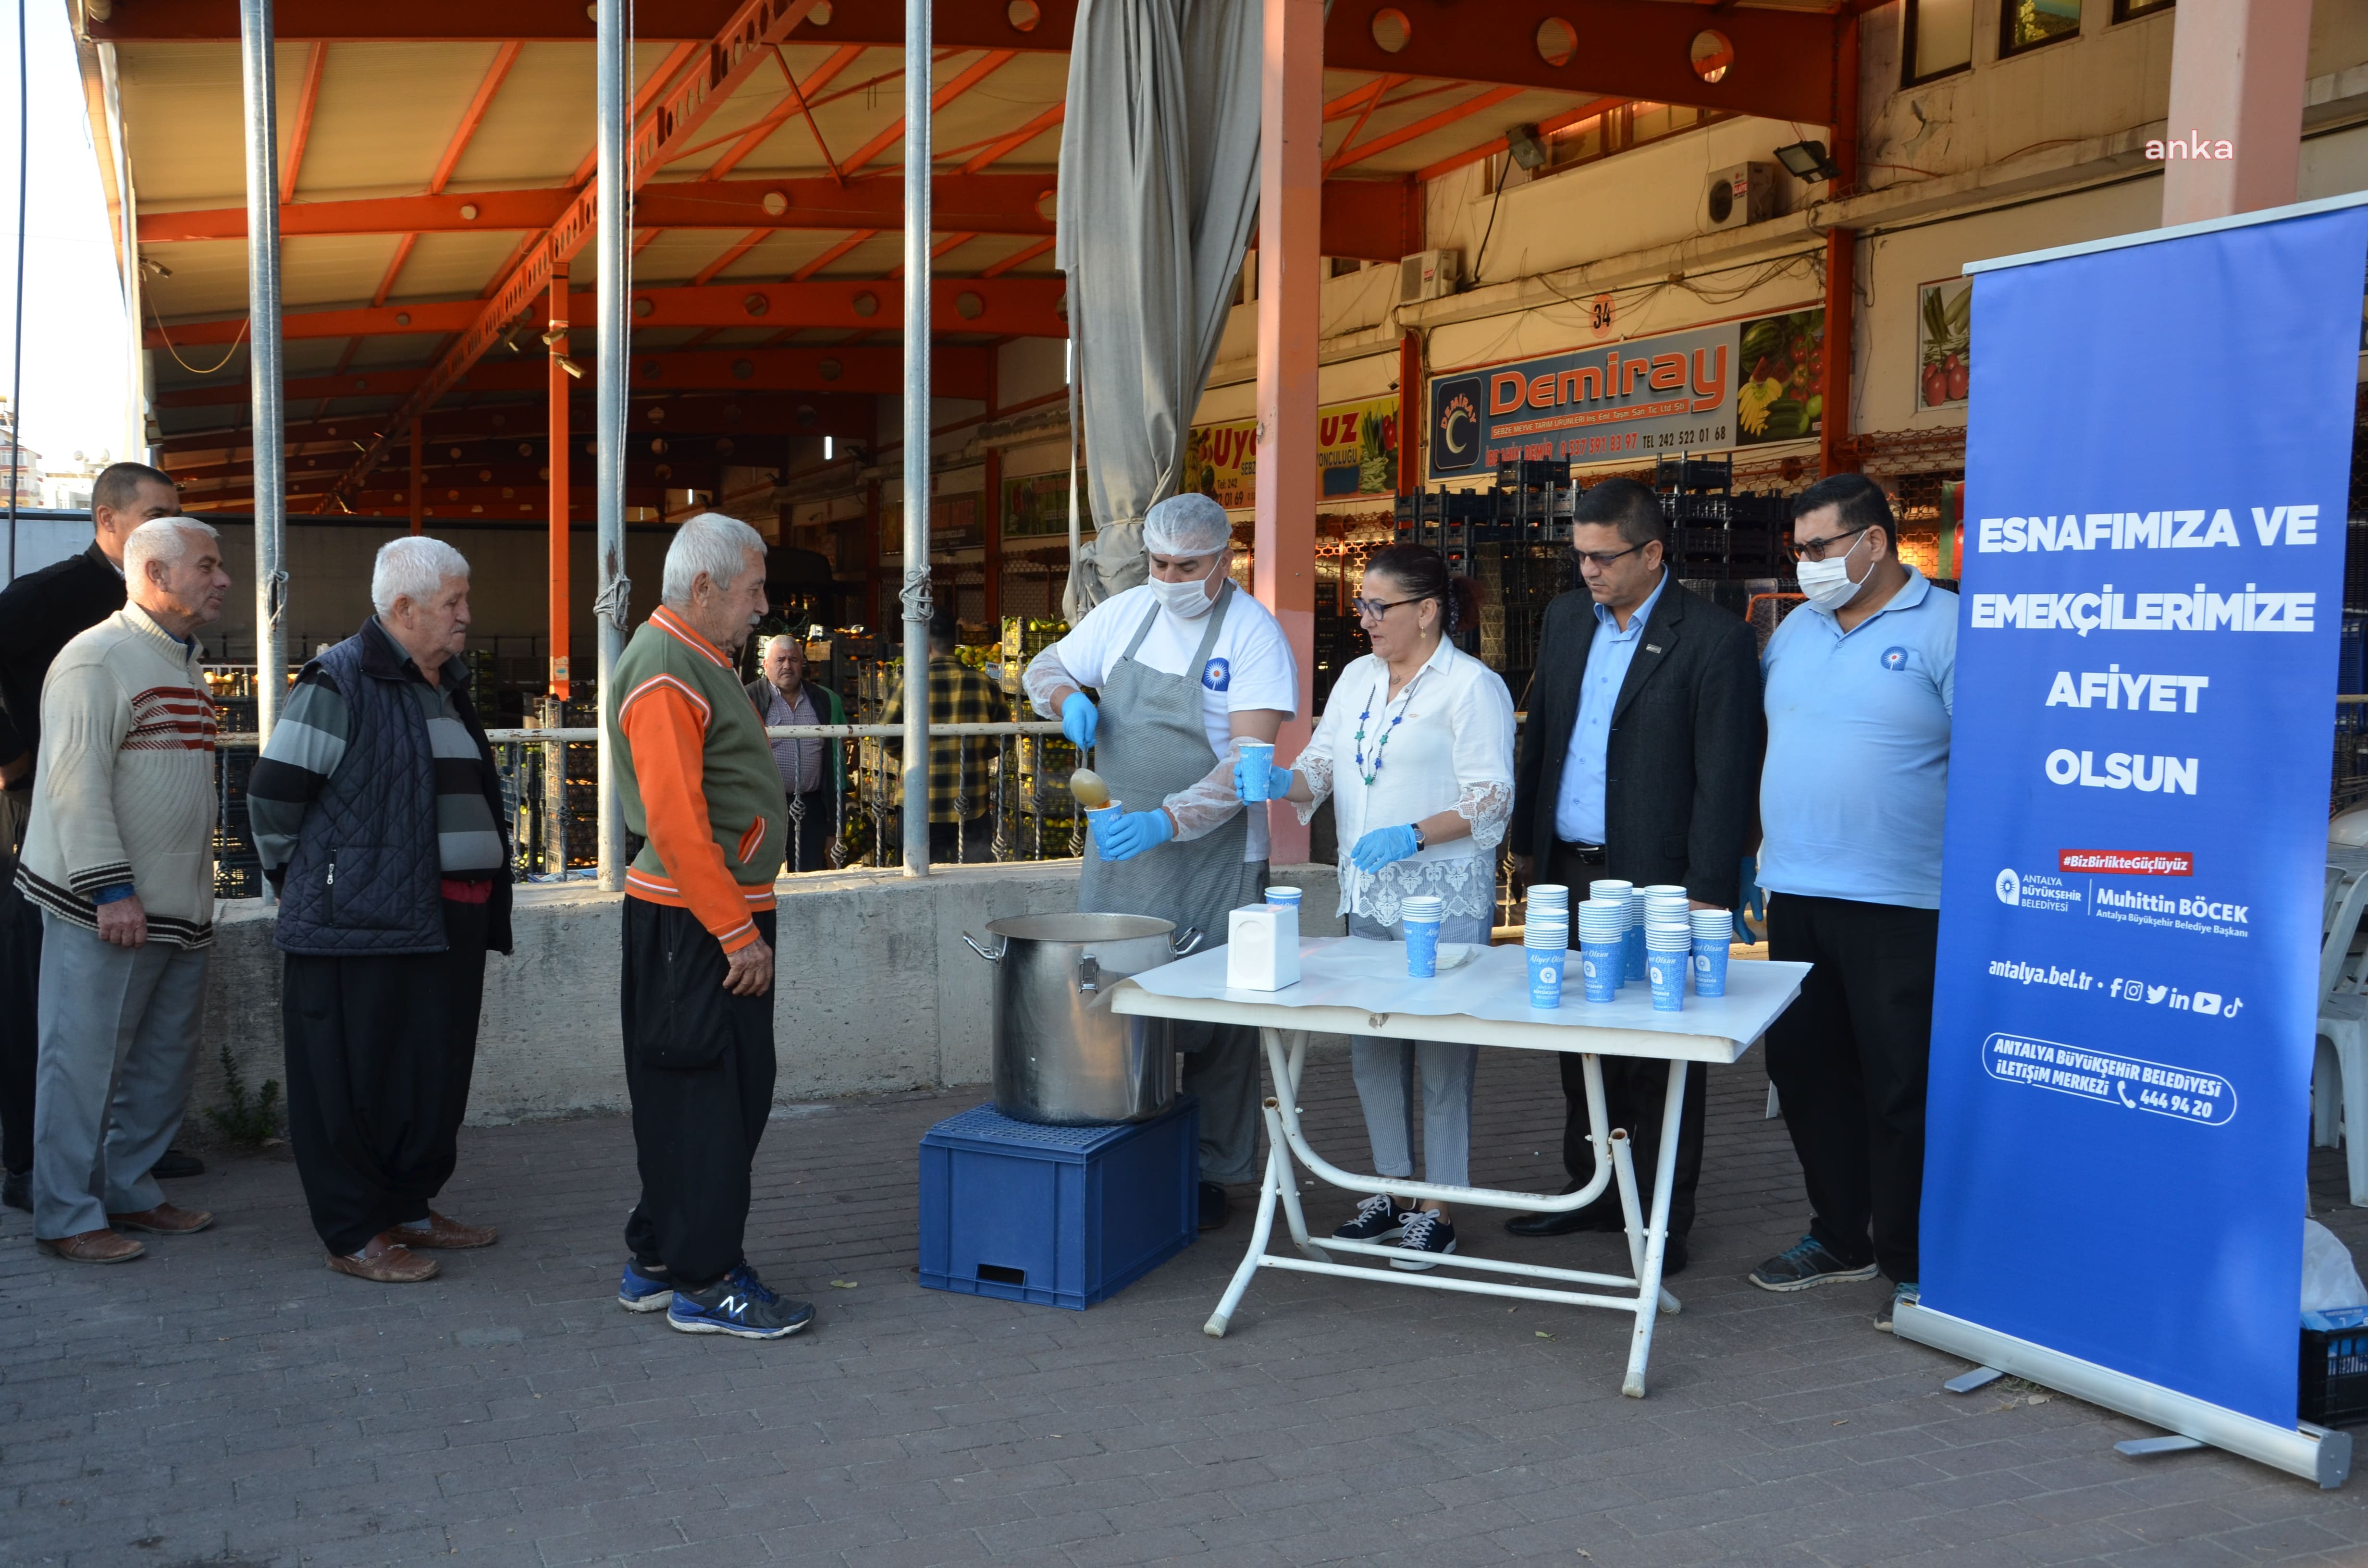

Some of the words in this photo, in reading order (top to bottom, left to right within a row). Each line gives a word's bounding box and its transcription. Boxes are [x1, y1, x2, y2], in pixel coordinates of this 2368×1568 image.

[1594, 302, 1611, 329] 34
[1490, 344, 1728, 416] Demiray
[1493, 426, 1512, 436] SEBZE
[1514, 424, 1533, 433] MEYVE
[1535, 420, 1553, 429] TARIM
[1643, 434, 1654, 449] TEL
[1659, 433, 1674, 447] 242
[1679, 430, 1695, 445] 522
[1699, 428, 1709, 442] 01
[1715, 426, 1726, 441] 68
[1560, 440, 1566, 458] 0
[1569, 438, 1586, 457] 537
[1589, 436, 1606, 454] 591
[1610, 433, 1622, 453] 83
[1626, 431, 1638, 450] 97
[1225, 491, 1233, 507] 01
[1234, 490, 1244, 505] 69
[1978, 508, 2240, 553] ESNAFIMIZA
[2251, 504, 2319, 547] VE
[1971, 583, 2316, 637] EMEKÇİLERİMİZE
[2045, 663, 2209, 713] AFİYET
[2045, 748, 2199, 796] OLSUN
[2063, 854, 2188, 874] #BizBirlikteGüçlüyüz
[2022, 874, 2063, 887] ANTALYA
[2022, 884, 2082, 902] BÜYÜKŞEHİR
[2021, 898, 2069, 912] BELEDİYESİ
[2096, 888, 2176, 914] Muhittin
[2179, 895, 2249, 924] BÖCEK
[2096, 909, 2127, 922] Antalya
[2128, 914, 2174, 928] Büyükşehir
[2175, 920, 2212, 934] Belediye
[2213, 925, 2248, 938] Başkanı
[1589, 950, 1609, 958] Olsun
[1655, 956, 1677, 964] Olsun
[1988, 960, 2094, 991] antalya.bel.tr
[1993, 1038, 2055, 1063] ANTALYA
[2056, 1049, 2141, 1081] BÜYÜKŞEHİR
[2142, 1066, 2222, 1098] BELEDİYESİ
[1996, 1059, 2051, 1084] İLETİŞİM
[2052, 1070, 2110, 1096] MERKEZİ
[2140, 1089, 2168, 1109] 444
[2171, 1095, 2190, 1114] 94
[2191, 1100, 2213, 1118] 20
